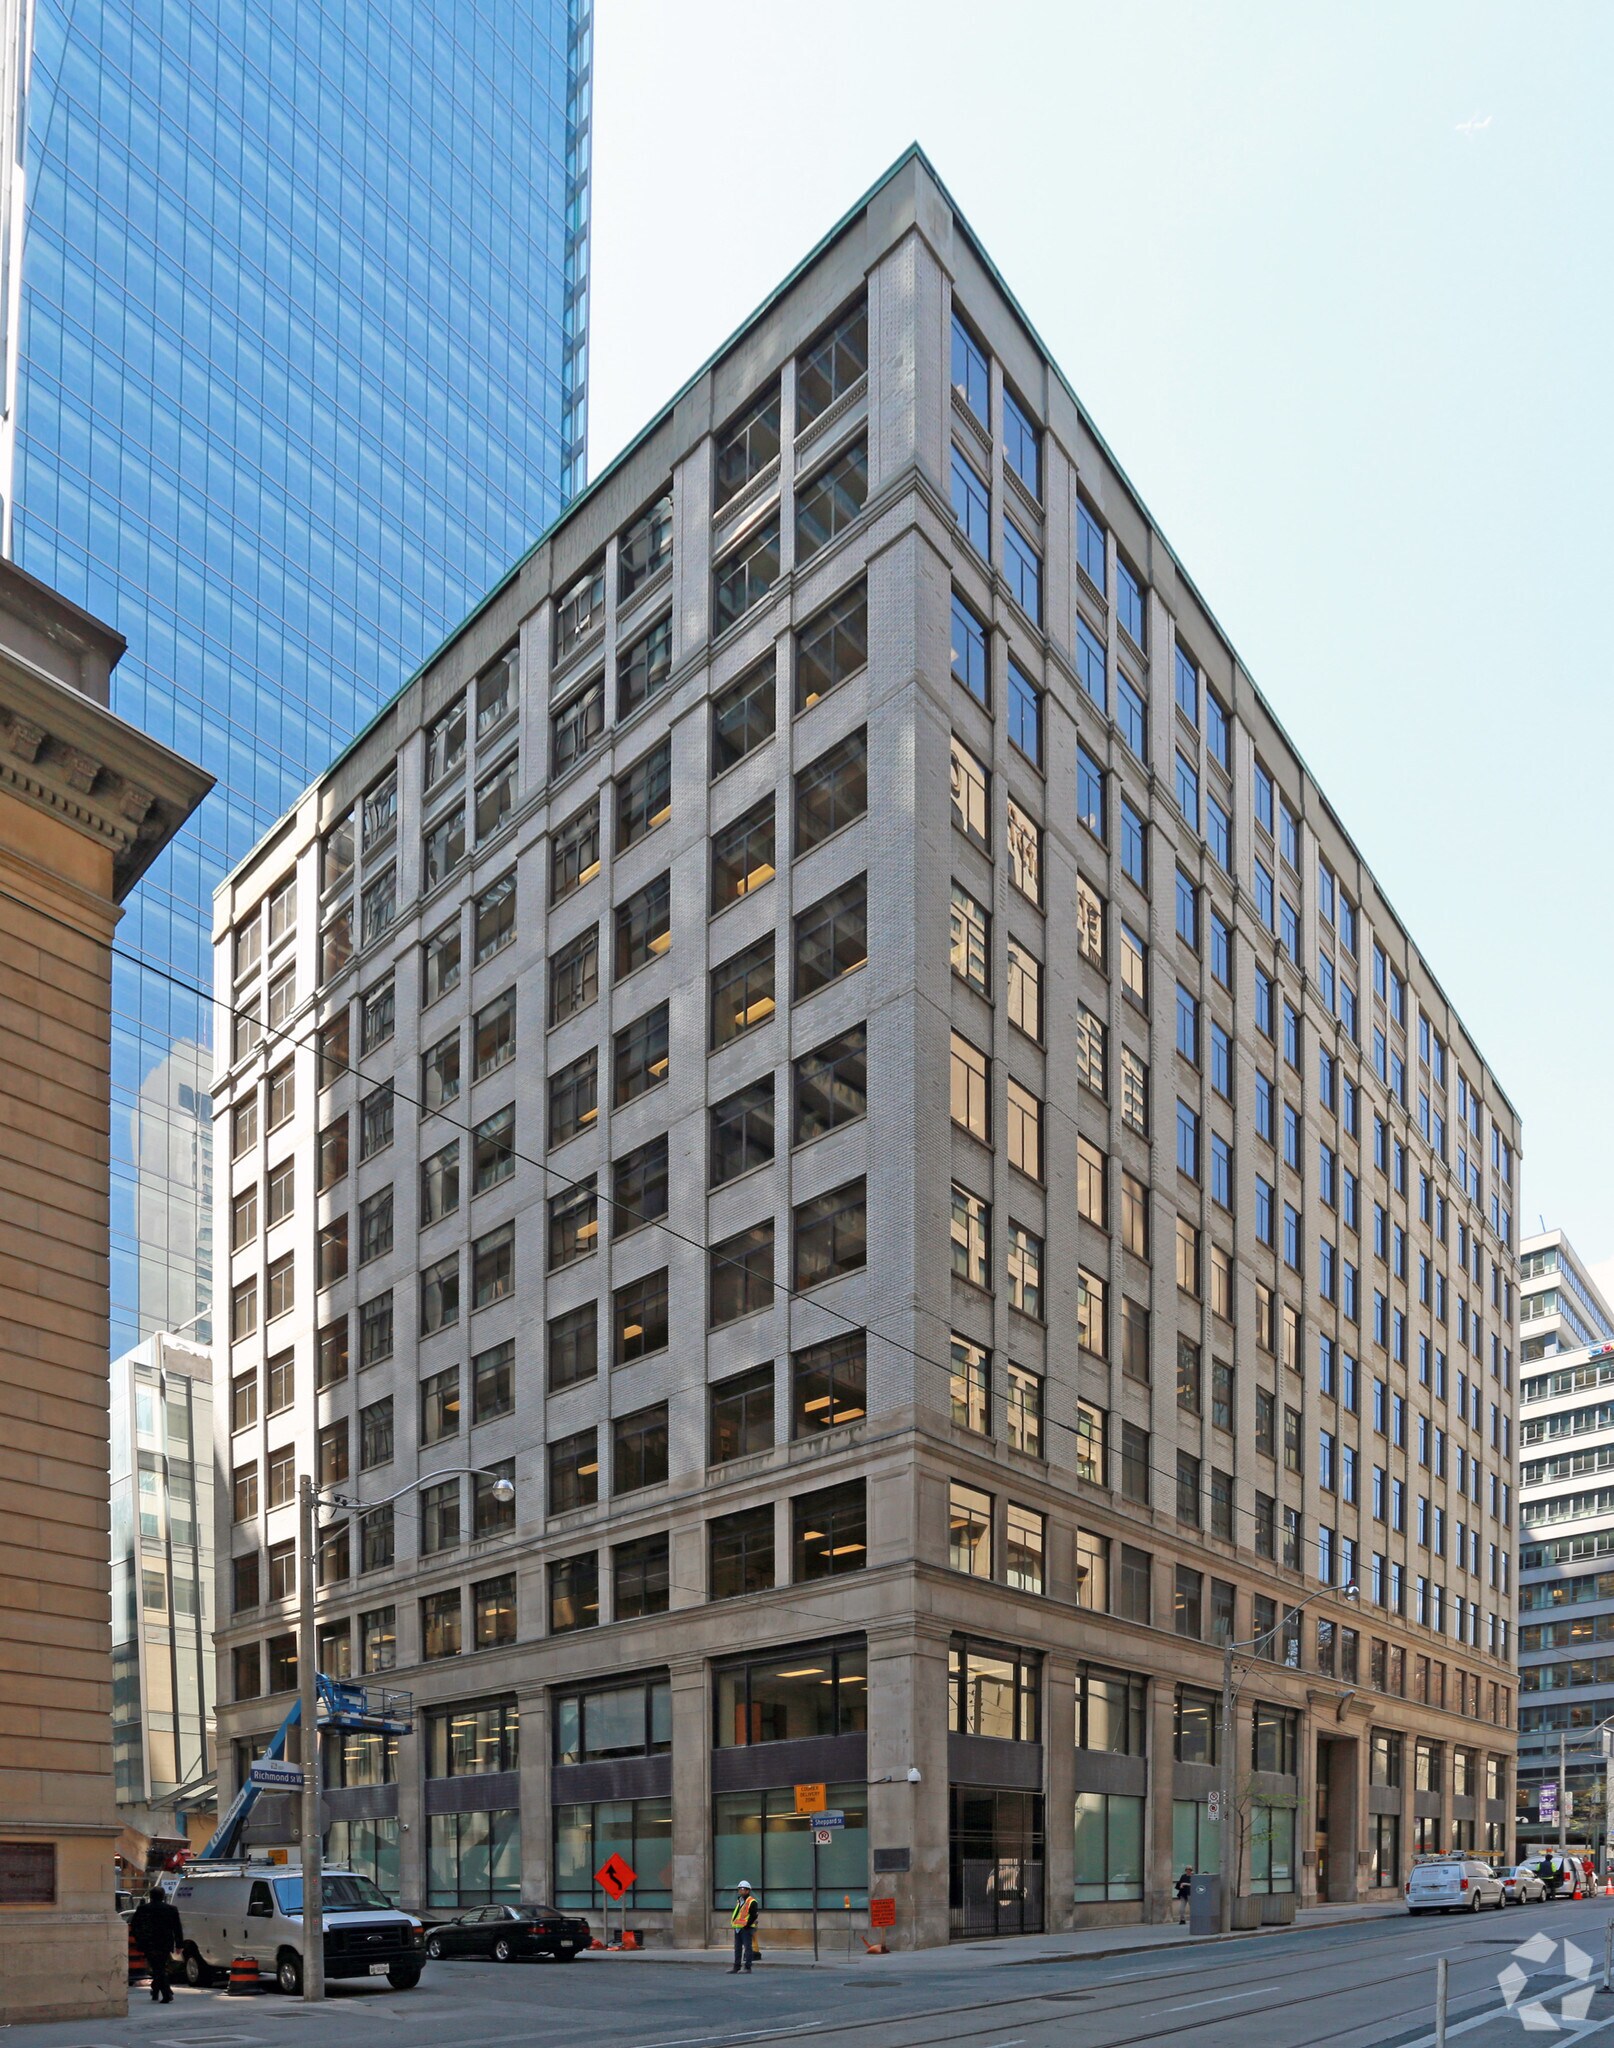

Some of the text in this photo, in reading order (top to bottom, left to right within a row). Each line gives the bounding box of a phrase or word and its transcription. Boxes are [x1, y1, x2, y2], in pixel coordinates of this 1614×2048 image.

[254, 1770, 289, 1782] Richmond
[296, 1775, 303, 1783] W
[814, 1818, 837, 1826] Sheppard
